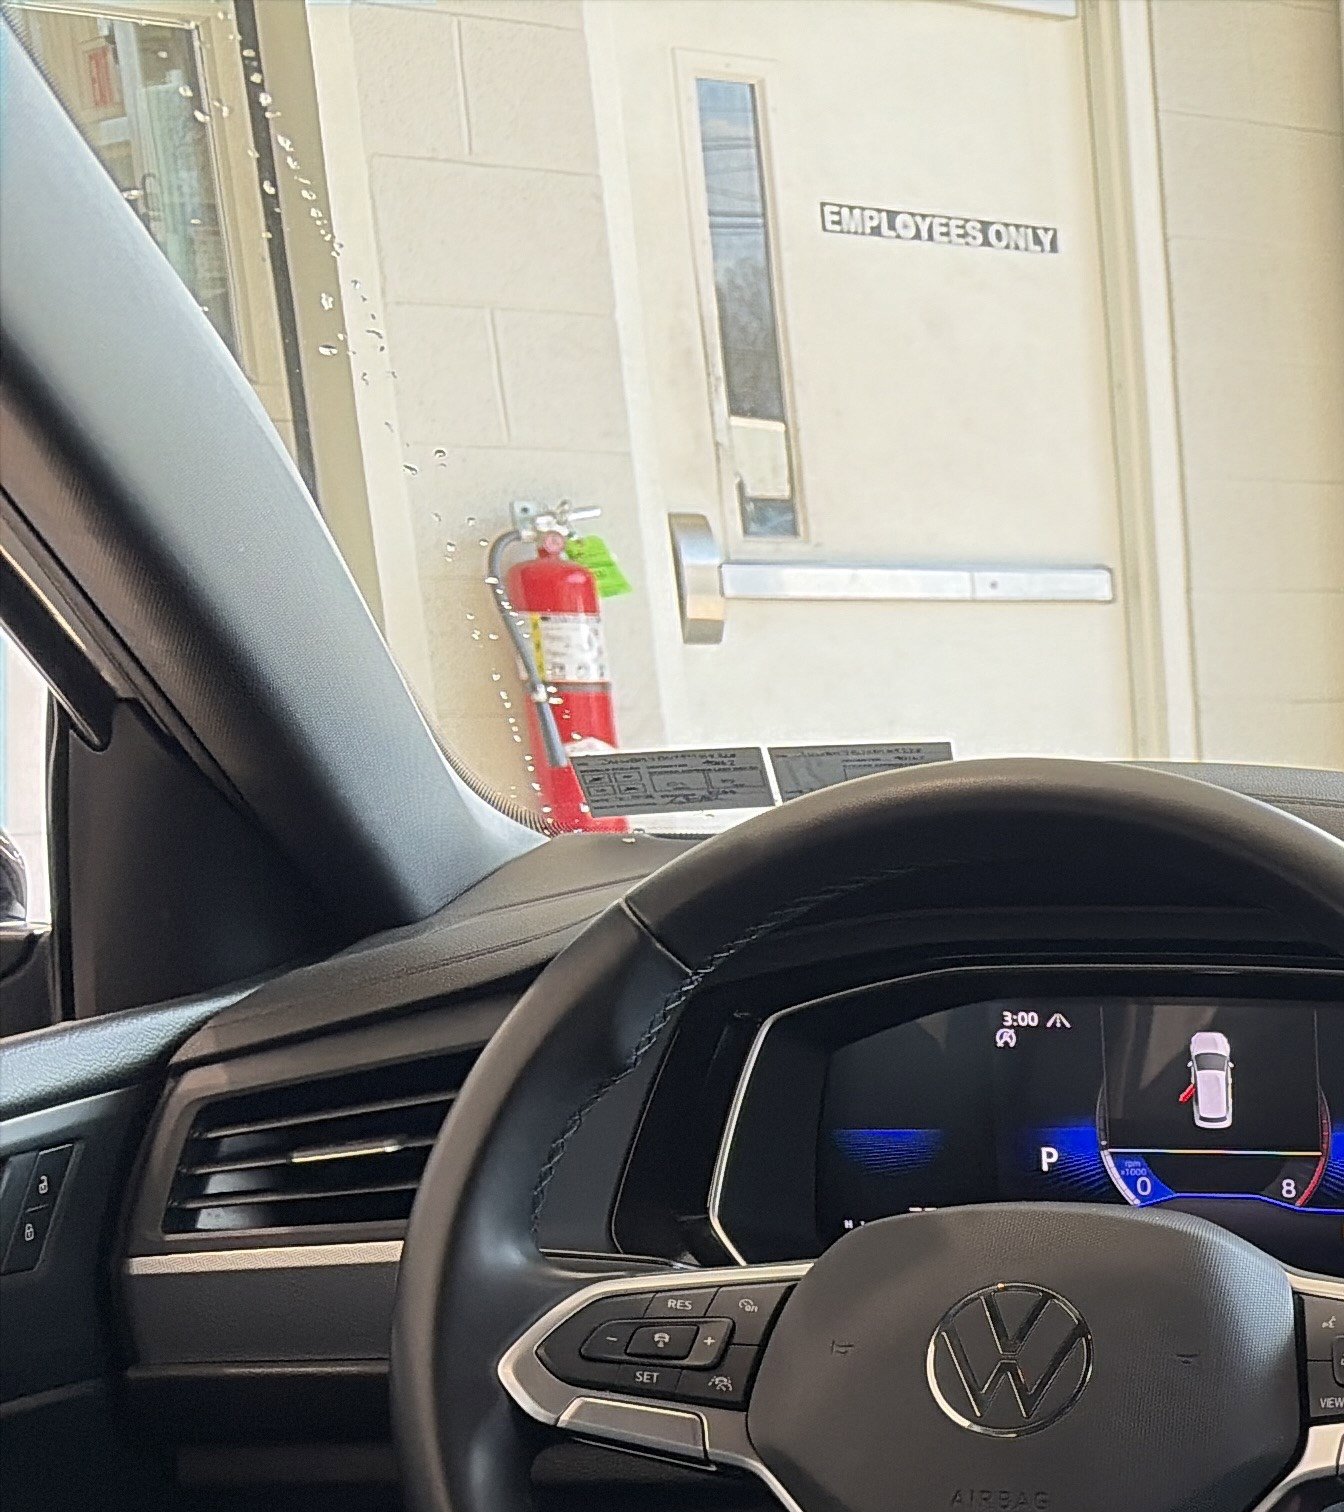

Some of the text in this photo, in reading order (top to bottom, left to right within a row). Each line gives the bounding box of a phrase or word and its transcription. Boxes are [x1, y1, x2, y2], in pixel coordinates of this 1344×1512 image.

[822, 203, 1055, 253] EMPLOYEES ONLY
[1002, 1010, 1039, 1027] 3:00
[1040, 1147, 1059, 1171] P
[1136, 1176, 1152, 1196] 0
[1281, 1178, 1297, 1199] 8
[667, 1298, 693, 1310] RES
[634, 1371, 660, 1384] SET
[951, 1488, 1049, 1511] AIRBAG
